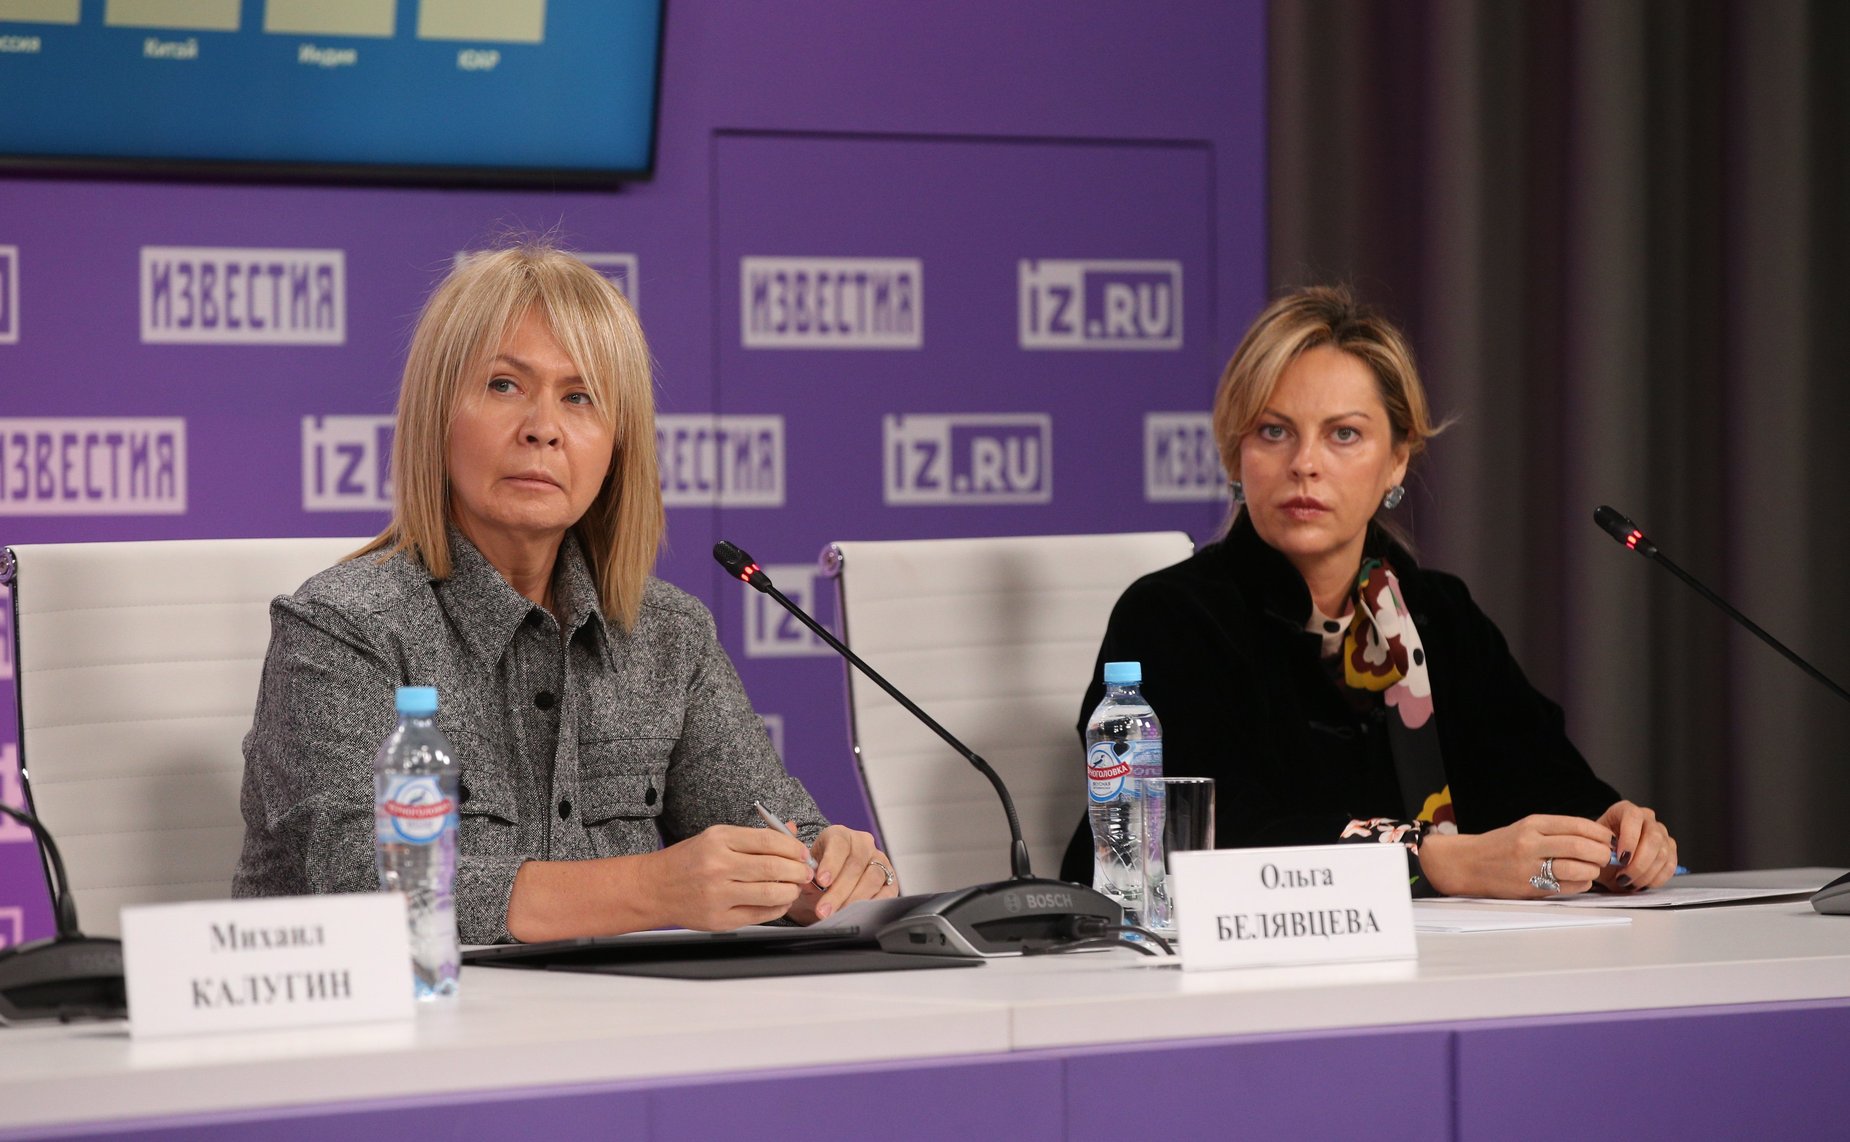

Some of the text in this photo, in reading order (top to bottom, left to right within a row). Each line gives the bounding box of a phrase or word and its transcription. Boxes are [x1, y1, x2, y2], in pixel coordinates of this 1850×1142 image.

[151, 261, 336, 330] ИЗВЕСТИЯ
[752, 271, 914, 334] ИЗВЕСТИЯ
[0, 432, 175, 501] ЗВЕСТИЯ
[1260, 863, 1335, 889] Ольга
[1026, 894, 1073, 909] BOSCH
[210, 922, 325, 952] Михаил
[1215, 909, 1381, 942] БЕЛЯВЦЕВА
[190, 970, 353, 1009] КАЛУГИН
